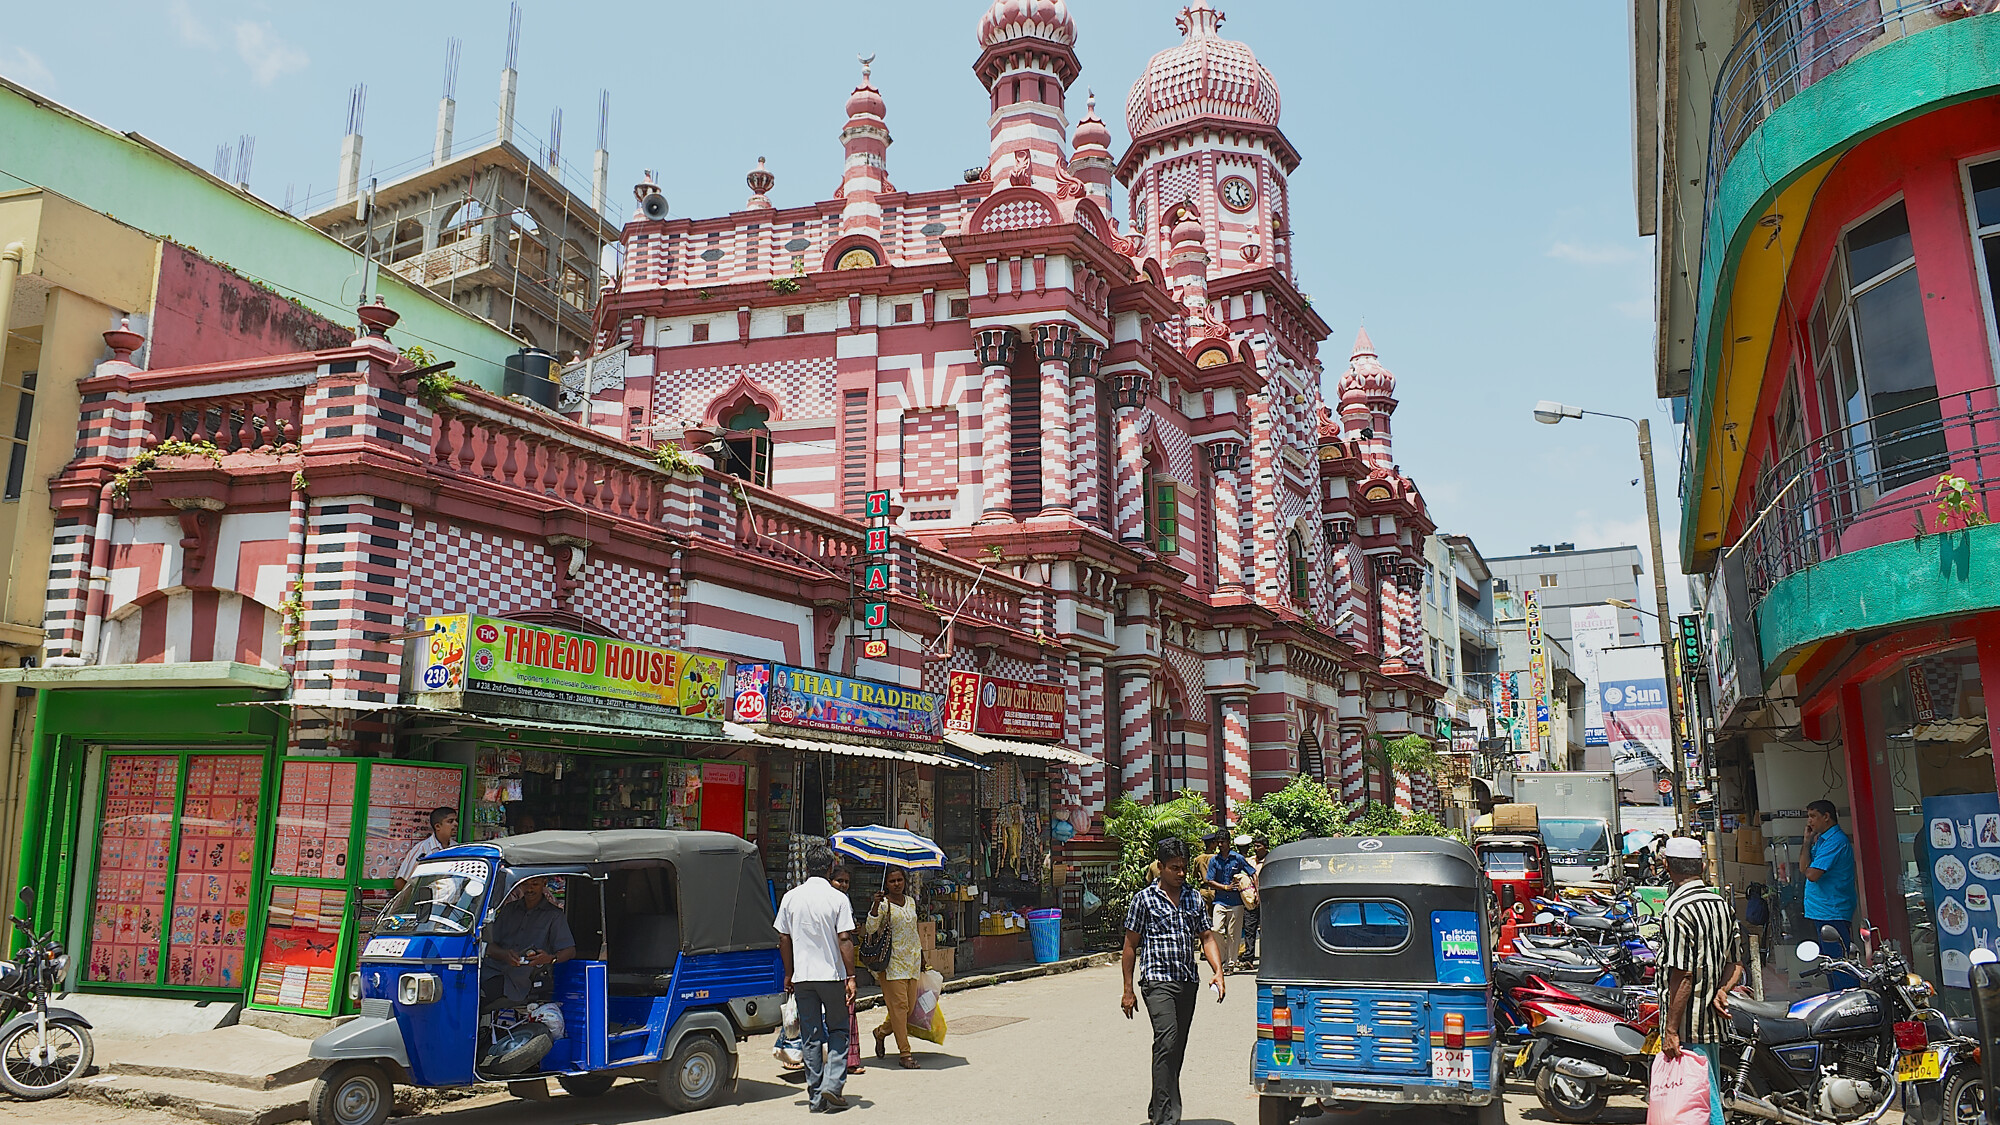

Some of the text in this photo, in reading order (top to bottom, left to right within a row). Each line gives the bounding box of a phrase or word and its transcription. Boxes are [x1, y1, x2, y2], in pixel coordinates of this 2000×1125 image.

[867, 492, 886, 627] THAJ
[1527, 594, 1541, 655] FASHION
[1574, 619, 1613, 628] BRIGHT
[869, 643, 883, 653] 236
[1684, 617, 1698, 663] LUCKY
[503, 625, 676, 688] THREAD HOUSE
[426, 667, 446, 685] 238
[516, 673, 544, 684] Importers
[551, 678, 579, 688] Wholesale
[580, 682, 601, 692] Dealers
[608, 686, 632, 696] Garments
[790, 671, 934, 712] THAJ TRADERS
[1532, 663, 1546, 706] PLAZA
[534, 689, 555, 699] Colombo
[949, 684, 963, 719] CITY
[960, 676, 976, 722] FASHION
[997, 685, 1064, 713] NEW CITY FASHION
[1624, 685, 1661, 703] Sun
[739, 695, 763, 713] 236
[780, 709, 793, 719] 236
[809, 721, 830, 729] Cross
[853, 726, 881, 735] Colombo
[949, 721, 970, 729] 234
[1620, 723, 1660, 735] Astra
[1440, 929, 1478, 941] Telecom
[1518, 926, 1547, 936] POLICE
[1435, 1051, 1470, 1062] 204-
[1910, 1053, 1924, 1066] MV
[1436, 1066, 1471, 1077] 3719
[1909, 1066, 1931, 1079] 1094
